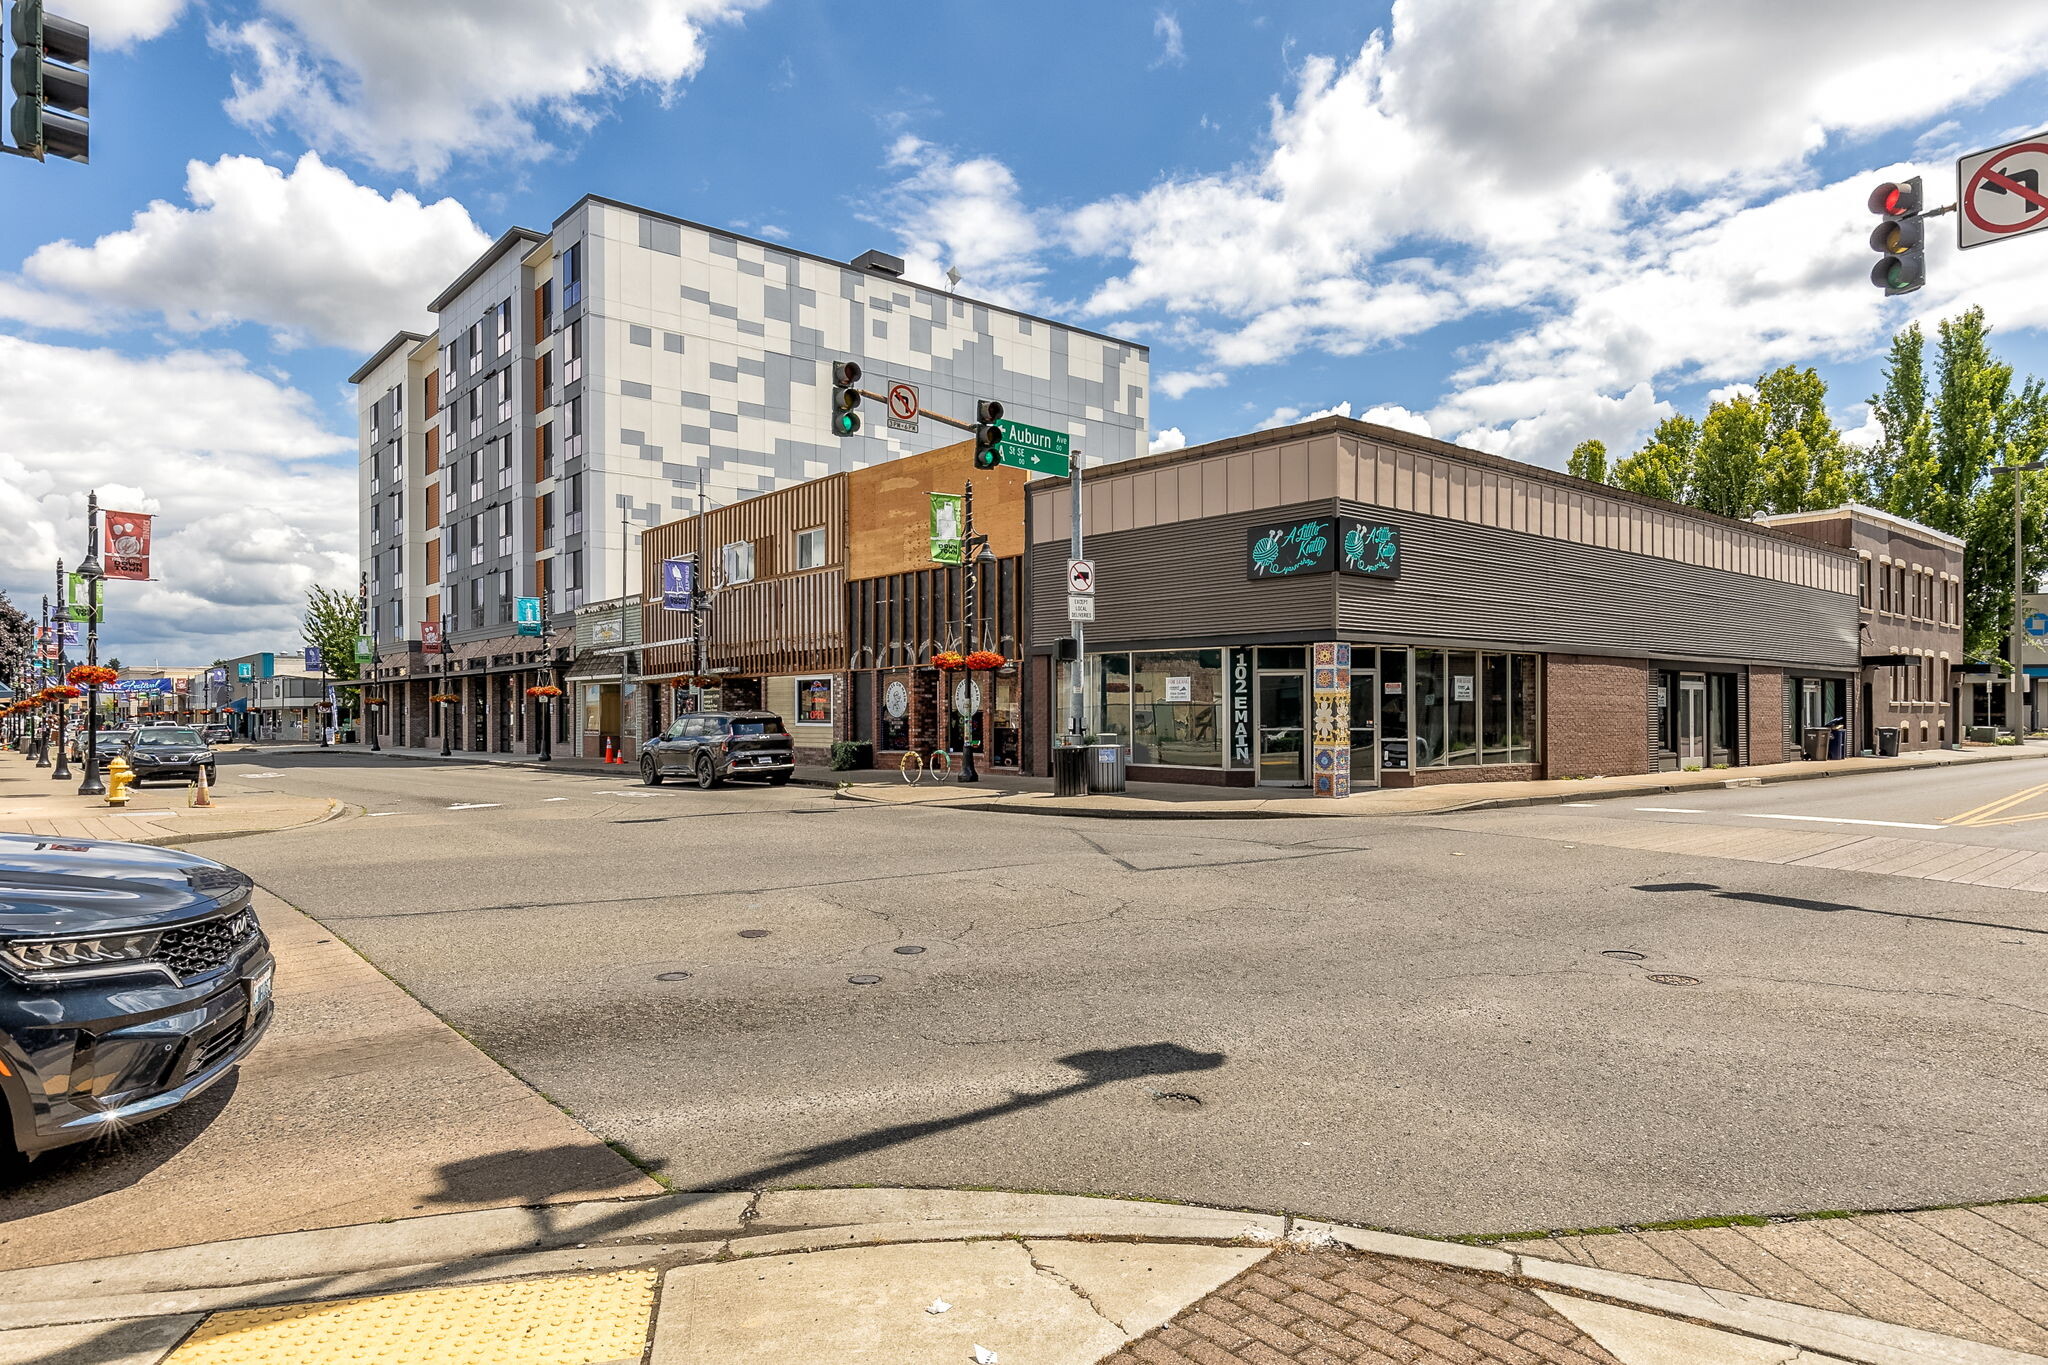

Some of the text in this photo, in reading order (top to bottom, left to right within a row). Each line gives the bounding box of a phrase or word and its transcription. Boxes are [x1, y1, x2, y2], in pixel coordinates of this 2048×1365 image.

[1009, 424, 1068, 449] Auburn Ave
[1009, 446, 1016, 455] St
[1017, 447, 1025, 457] SE
[1281, 521, 1329, 547] A Little
[1365, 527, 1375, 544] A
[1296, 536, 1327, 559] Knitty
[114, 560, 143, 568] DOWN
[1234, 653, 1248, 693] 102
